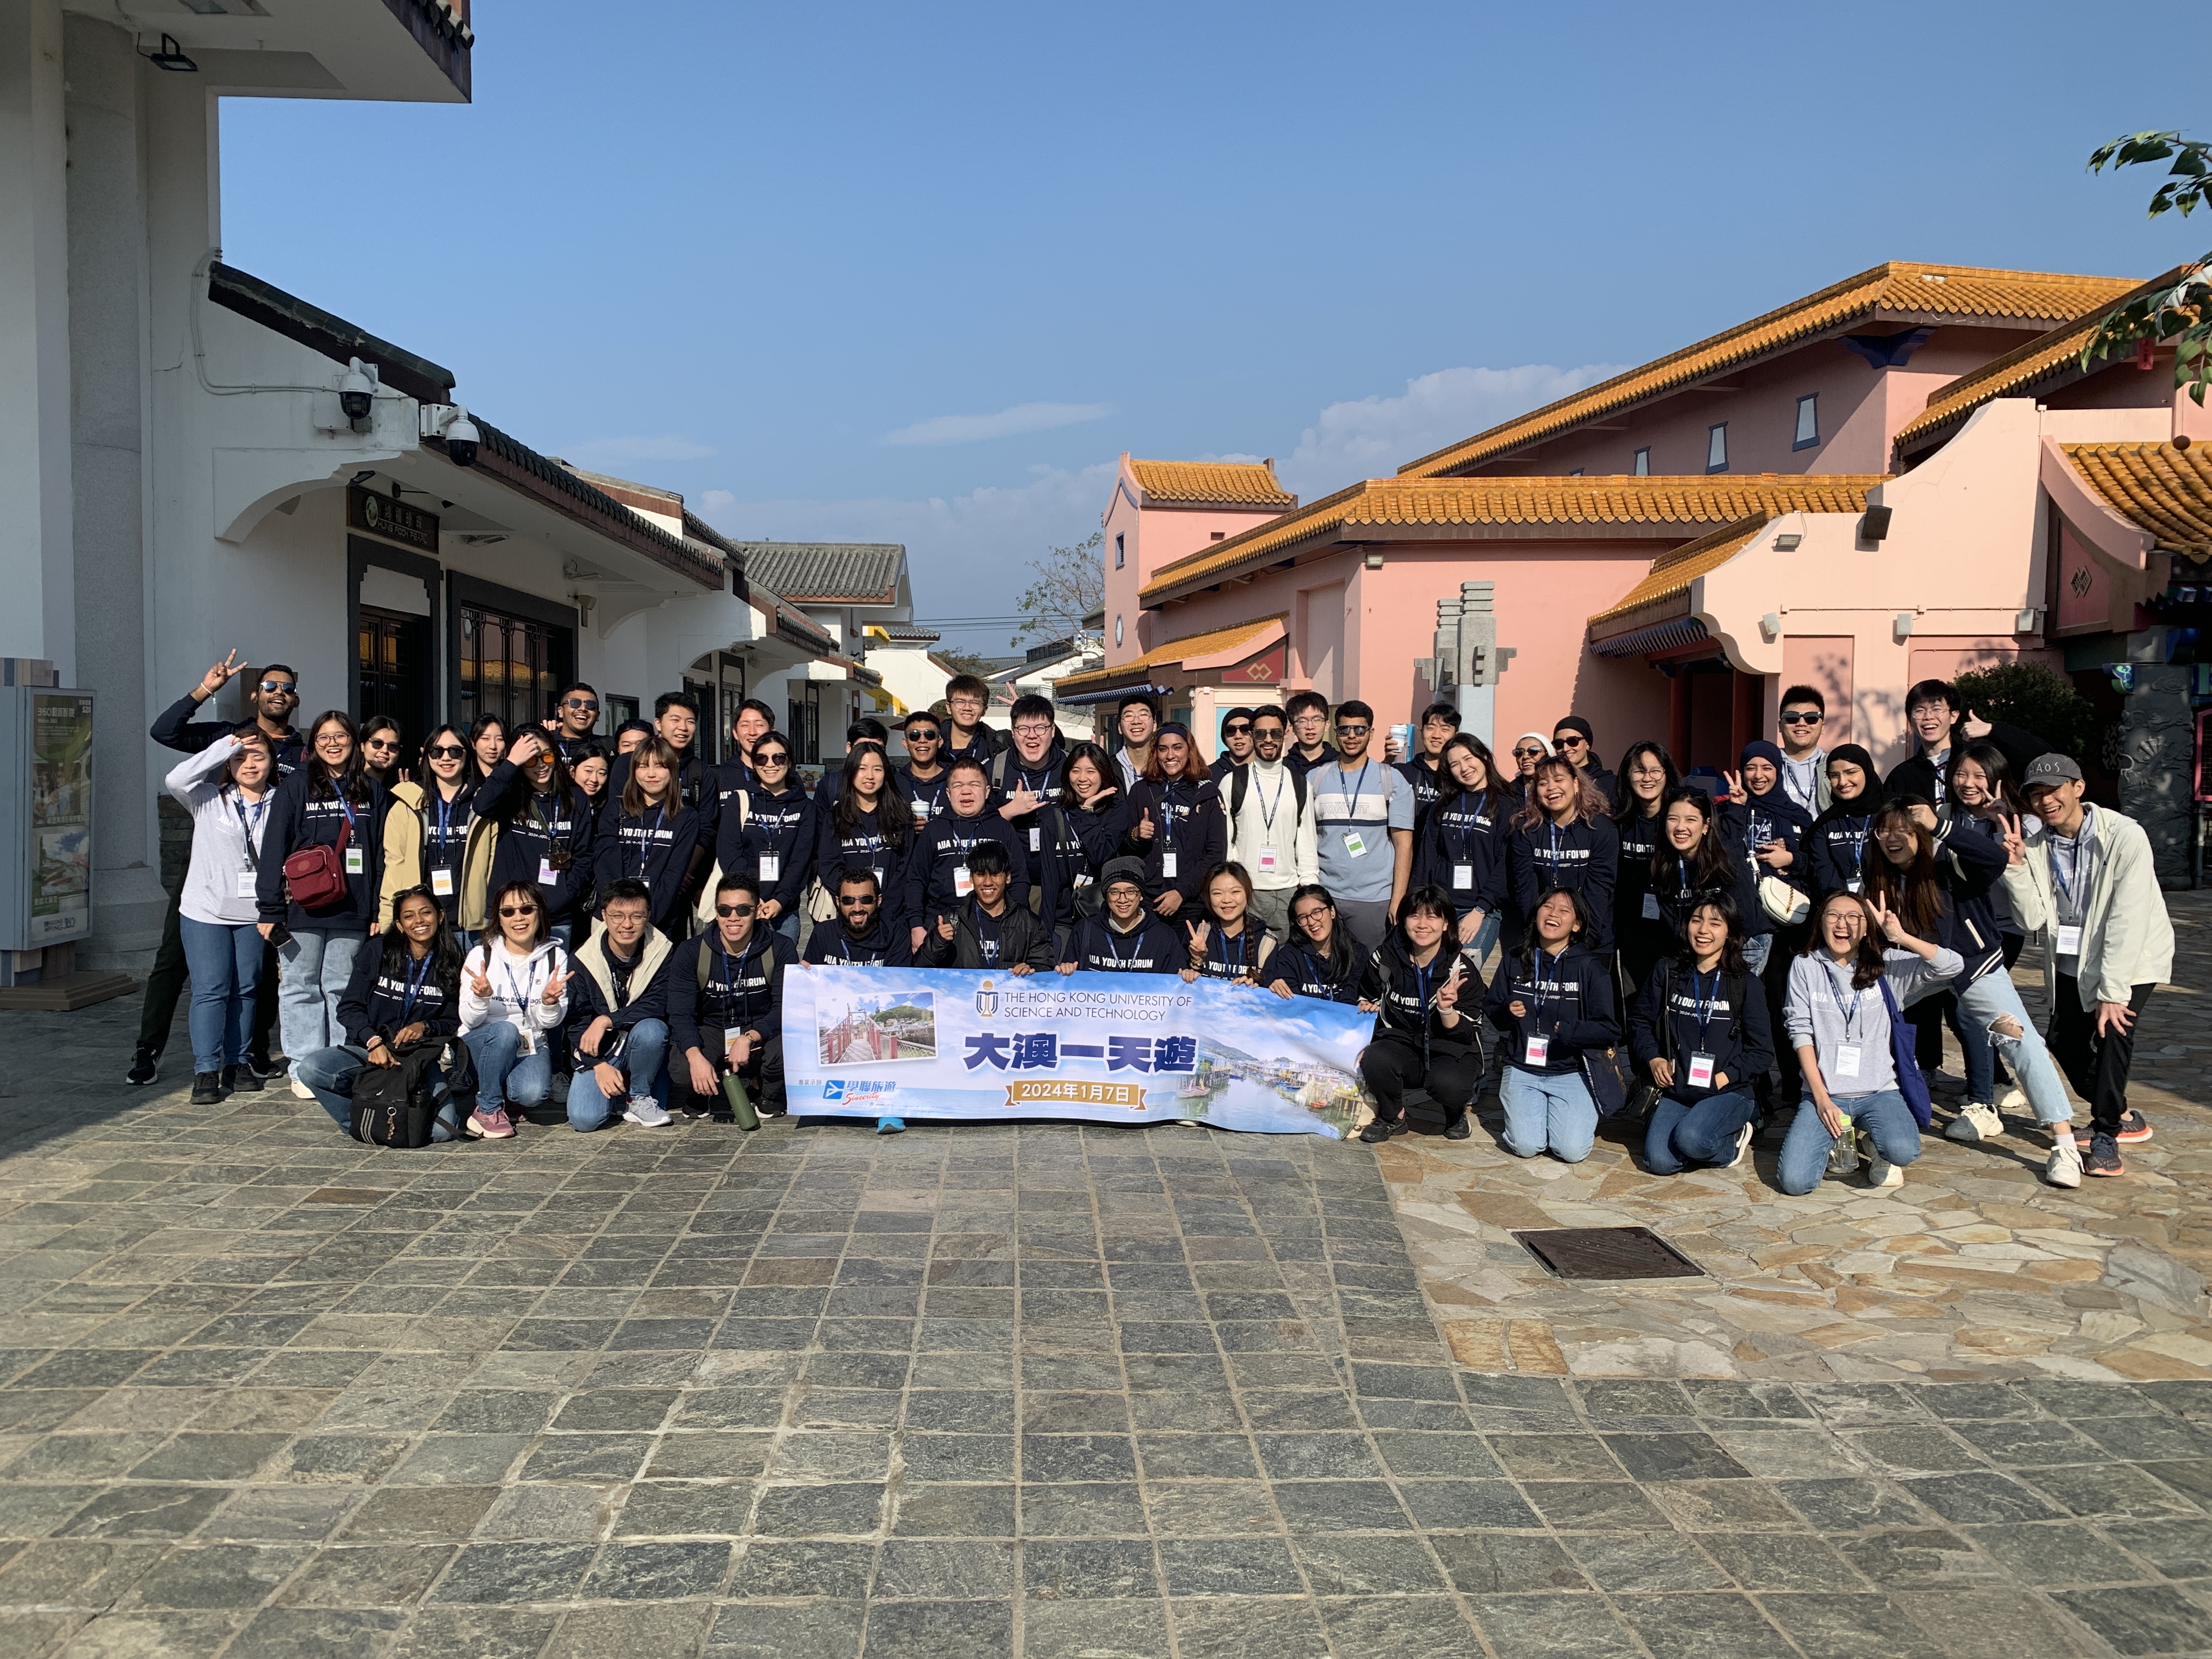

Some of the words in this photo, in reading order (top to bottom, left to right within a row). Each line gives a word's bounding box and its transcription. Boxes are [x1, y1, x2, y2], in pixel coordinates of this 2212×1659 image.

[278, 763, 296, 774] ORU
[937, 840, 951, 851] AUA
[953, 839, 977, 848] YUH
[1005, 992, 1025, 1003] THE
[1029, 992, 1066, 1003] HONG
[1069, 992, 1106, 1004] KONG
[1110, 994, 1174, 1007] UNIVERSITY
[1177, 996, 1192, 1007] OF
[1390, 991, 1400, 1003] UA
[1812, 991, 1828, 1003] AUA
[1004, 1007, 1052, 1018] SCIENCE
[1056, 1007, 1082, 1018] AND
[1085, 1007, 1166, 1022] TECHNOLOGY
[963, 1032, 1197, 1073] 大澳一天遊
[846, 1080, 898, 1093] 學聯旅遊
[1022, 1082, 1130, 1102] 2024年1月7日
[842, 1092, 882, 1106] Sincerity
